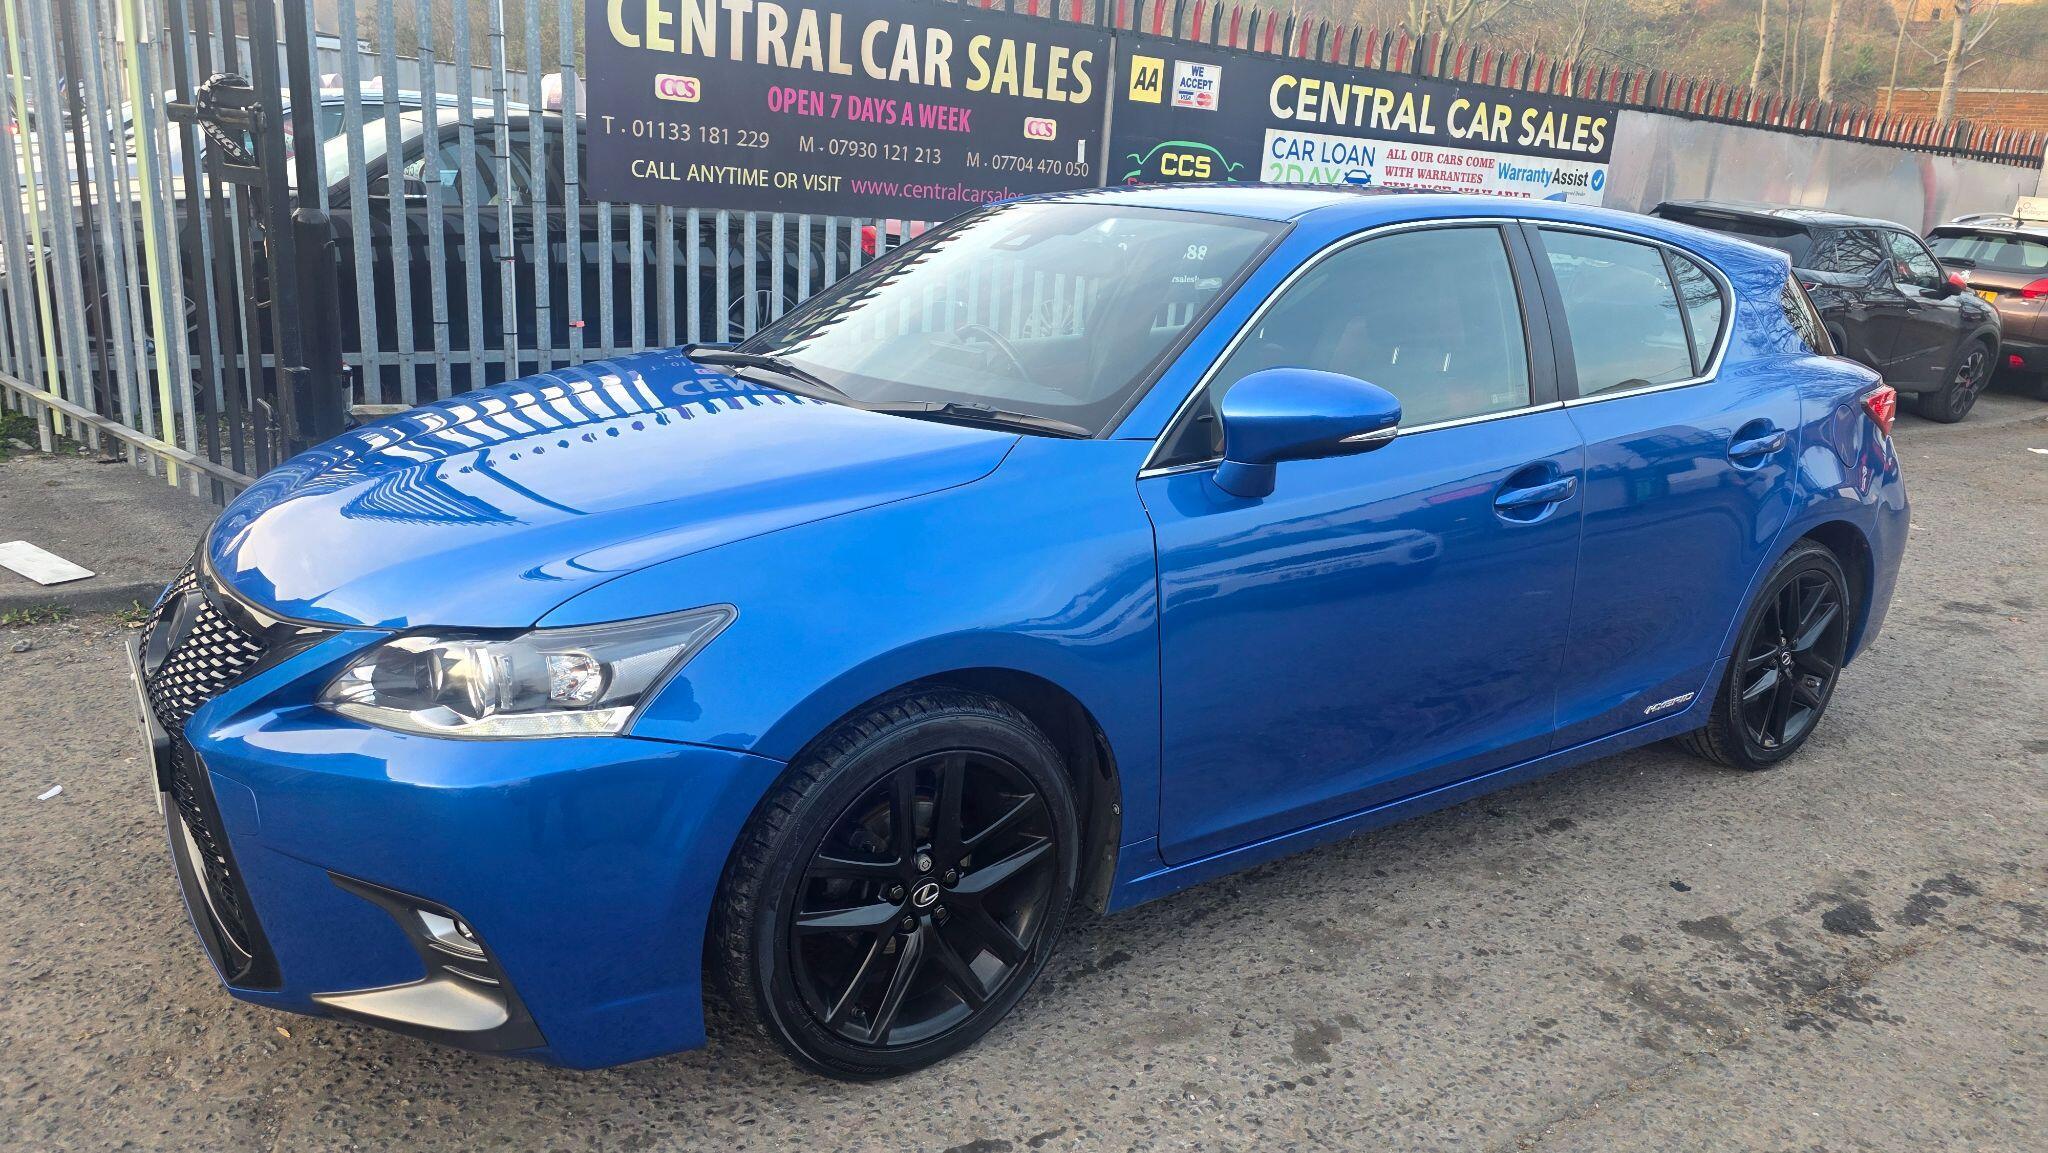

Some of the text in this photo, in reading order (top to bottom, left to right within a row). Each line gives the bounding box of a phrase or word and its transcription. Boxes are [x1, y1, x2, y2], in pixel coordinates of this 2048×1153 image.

[607, 0, 1093, 104] CENTRAL CAR SALES
[1133, 66, 1159, 92] AA
[1179, 77, 1213, 90] ACCEPT
[1191, 65, 1204, 77] WE
[660, 77, 696, 98] CCS
[767, 86, 972, 133] OPEN 7 DAYS A WEEK
[1269, 74, 1607, 154] CENTRAL CAR SALES
[632, 119, 691, 142] 01133
[699, 126, 729, 145] 181
[736, 129, 770, 149] 229
[1027, 120, 1053, 138] CCS
[828, 138, 878, 159] 07930
[883, 144, 908, 162] 121
[914, 147, 941, 165] 213
[1272, 136, 1376, 167] CAR LOAN
[1386, 148, 1495, 169] ALL OUR CARS COME
[631, 159, 681, 182] CALL
[687, 163, 769, 187] ANYTIME
[774, 170, 798, 189] OR
[802, 173, 842, 192] VISIT
[992, 155, 1034, 173] 07704
[1037, 158, 1062, 175] 470
[1065, 162, 1089, 177] 050
[1160, 152, 1211, 178] CCS
[1270, 162, 1341, 184] 2DAY
[1385, 165, 1484, 184] WITH WARRANTIES
